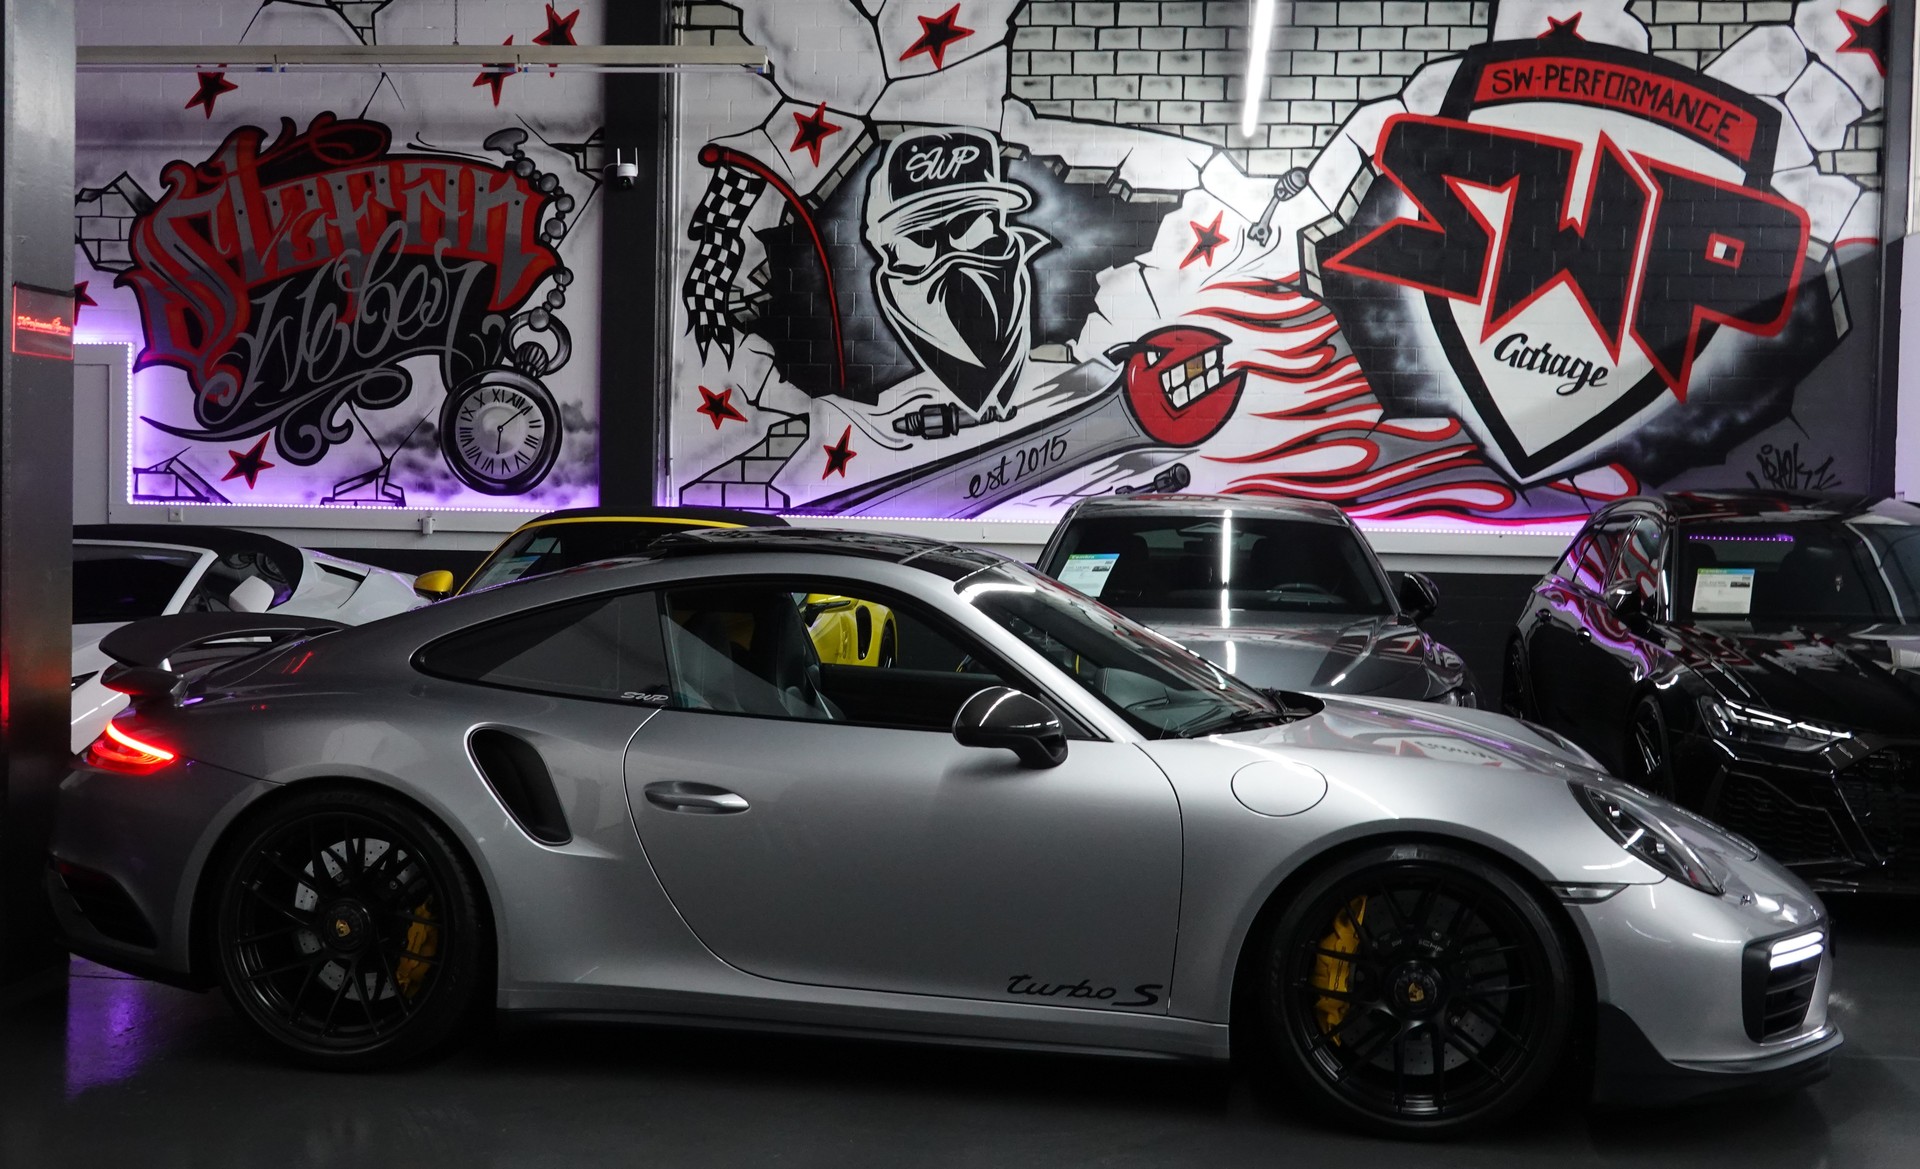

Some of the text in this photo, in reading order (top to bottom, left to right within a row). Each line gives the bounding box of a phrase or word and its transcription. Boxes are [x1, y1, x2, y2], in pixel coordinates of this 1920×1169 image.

[1492, 64, 1741, 144] SW-PERFORMANCE
[905, 145, 980, 183] SWP
[1322, 113, 1811, 402] SWP
[1493, 332, 1609, 396] Garage
[963, 428, 1072, 499] est 2015
[1006, 974, 1163, 1007] turbo S
